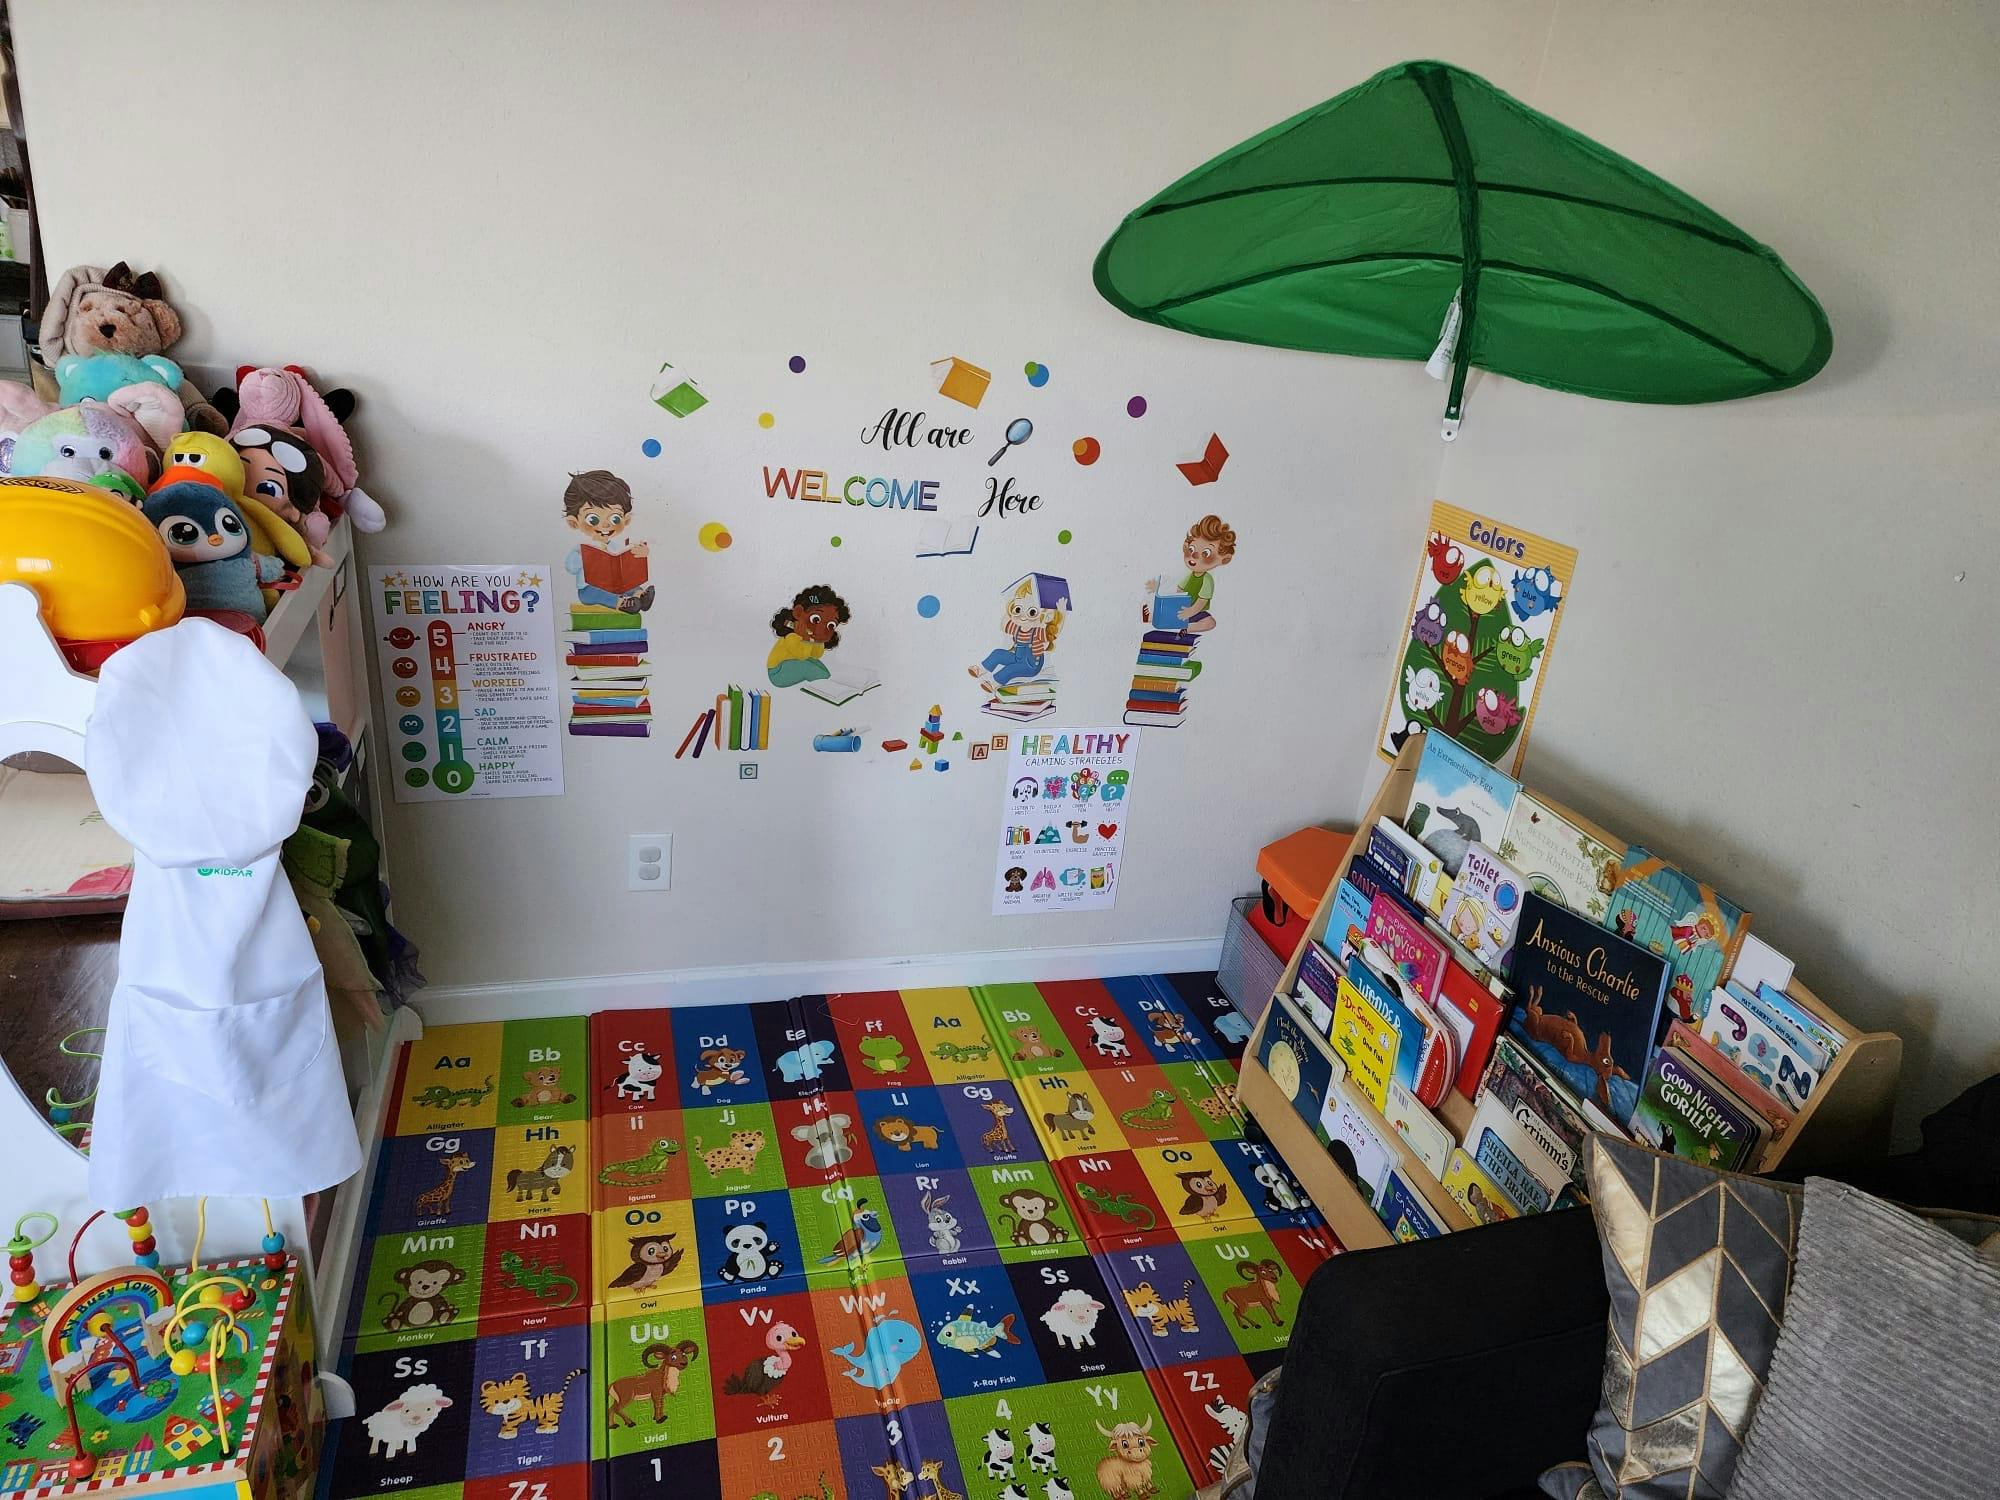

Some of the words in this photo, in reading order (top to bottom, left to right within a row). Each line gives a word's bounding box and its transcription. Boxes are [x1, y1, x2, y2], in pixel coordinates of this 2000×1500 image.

[861, 408, 925, 450] All
[927, 426, 975, 449] are
[763, 466, 940, 511] WELCOME
[977, 477, 1043, 519] Here
[1469, 520, 1526, 559] Colors
[413, 575, 444, 587] HOW
[451, 575, 478, 587] ARE
[486, 575, 511, 586] YOU
[384, 590, 540, 615] FEELING?
[1474, 593, 1494, 607] yellow
[1522, 588, 1537, 603] blue
[468, 621, 505, 631] ANGRY
[1420, 625, 1438, 640] purple
[432, 628, 447, 647] 5
[436, 656, 451, 674] 4
[469, 652, 537, 662] FRUSTRATED
[1445, 656, 1466, 672] orange
[1501, 651, 1521, 664] green
[471, 678, 525, 688] WORRIED
[440, 686, 453, 704] 3
[1415, 690, 1430, 702] white
[474, 707, 496, 717] SAD
[442, 715, 456, 733] 2
[1482, 715, 1496, 728] pink
[477, 736, 509, 746] CALM
[1021, 733, 1130, 756] HEALTHY
[479, 761, 515, 770] HAPPY
[1025, 757, 1066, 767] CALMING
[1069, 756, 1123, 765] STRATEGIES
[1427, 742, 1436, 754] An
[1437, 748, 1479, 783] Extraordinary
[1480, 777, 1494, 794] Egg
[446, 770, 461, 787] 0
[1516, 828, 1545, 856] Nursery
[1547, 851, 1575, 878] Rhyme
[1560, 847, 1591, 872] POTTER
[214, 868, 253, 877] KIDPAR
[1468, 853, 1500, 883] Toilet
[1469, 871, 1490, 893] Time
[1525, 917, 1582, 969] Anxious
[1586, 946, 1640, 1001] Charlie
[1546, 958, 1558, 974] to
[1558, 965, 1574, 985] the
[1576, 978, 1610, 1005] Rescue
[1207, 995, 1230, 1008] Ee
[1002, 1009, 1031, 1023] Bb
[1075, 1005, 1100, 1017] Cc
[1344, 994, 1356, 1015] Dr.
[1356, 1006, 1375, 1035] Seuss
[865, 1020, 884, 1033] Ff
[933, 1016, 962, 1028] Aa
[700, 1034, 728, 1048] Dd
[785, 1029, 807, 1041] Ee
[618, 1040, 645, 1052] Cc
[1362, 1037, 1372, 1052] One
[1373, 1048, 1384, 1065] fish
[434, 1055, 471, 1070] Aa
[528, 1047, 561, 1063] Bb
[956, 1073, 985, 1081] Alligator
[1361, 1060, 1371, 1074] two
[1372, 1072, 1382, 1088] fish
[1039, 1077, 1069, 1090] Hh
[1356, 1078, 1365, 1089] red
[1366, 1086, 1376, 1103] fish
[962, 1085, 993, 1100] Gg
[1660, 1062, 1693, 1095] GOOD
[1691, 1089, 1736, 1138] NIGHT
[533, 1113, 553, 1121] Bear
[719, 1109, 736, 1126] Jj
[1660, 1083, 1713, 1138] GORILLA
[426, 1121, 465, 1131] Alligator
[1343, 1114, 1365, 1146] Cerca
[525, 1127, 559, 1142] Hh
[1516, 1108, 1569, 1171] Grimm's
[425, 1136, 461, 1153] Gg
[1077, 1143, 1097, 1151] Horse
[1162, 1149, 1194, 1163] Oo
[1079, 1157, 1112, 1175] Nn
[1485, 1136, 1519, 1179] SHEILA
[1520, 1176, 1542, 1203] RAE
[915, 1175, 940, 1192] Rr
[992, 1168, 1034, 1184] Mm
[1484, 1150, 1504, 1179] THE
[1504, 1175, 1530, 1208] BRAV
[725, 1183, 751, 1192] Jaguar
[628, 1193, 656, 1202] Iguana
[724, 1199, 757, 1218] Pp
[417, 1217, 447, 1226] Giraffe
[625, 1208, 662, 1227] Oo
[519, 1221, 557, 1241] Nn
[1212, 1224, 1228, 1233] Owl
[400, 1234, 455, 1256] Mm
[1122, 1236, 1143, 1245] Newt
[1030, 1247, 1060, 1257] Monkey
[1214, 1243, 1250, 1262] Uu
[942, 1256, 968, 1266] Rabbit
[1130, 1254, 1158, 1273] Tt
[1040, 1267, 1070, 1286] Ss
[740, 1284, 767, 1295] Panda
[945, 1277, 982, 1298] Xx
[640, 1300, 658, 1310] Owl
[840, 1291, 886, 1316] Ww
[59, 1318, 80, 1339] My
[76, 1286, 115, 1314] Busy
[739, 1306, 774, 1327] Vv
[522, 1316, 547, 1327] Newt
[397, 1331, 435, 1343] Monkey
[630, 1322, 670, 1345] Uu
[520, 1338, 549, 1361] Tt
[1179, 1348, 1200, 1360] Tiger
[393, 1356, 428, 1379] Ss
[1080, 1363, 1106, 1373] Sheep
[973, 1378, 998, 1389] X-Ray
[998, 1374, 1017, 1386] Fish
[1183, 1369, 1221, 1392] Zz
[1085, 1384, 1118, 1410] Yy
[995, 1398, 1013, 1421] 4
[756, 1411, 789, 1425] Vulture
[643, 1431, 668, 1444] Urial
[886, 1419, 904, 1446] 3
[767, 1436, 786, 1461] 2
[517, 1453, 543, 1466] Tiger
[650, 1457, 662, 1482] 1
[380, 1474, 414, 1487] Sheep
